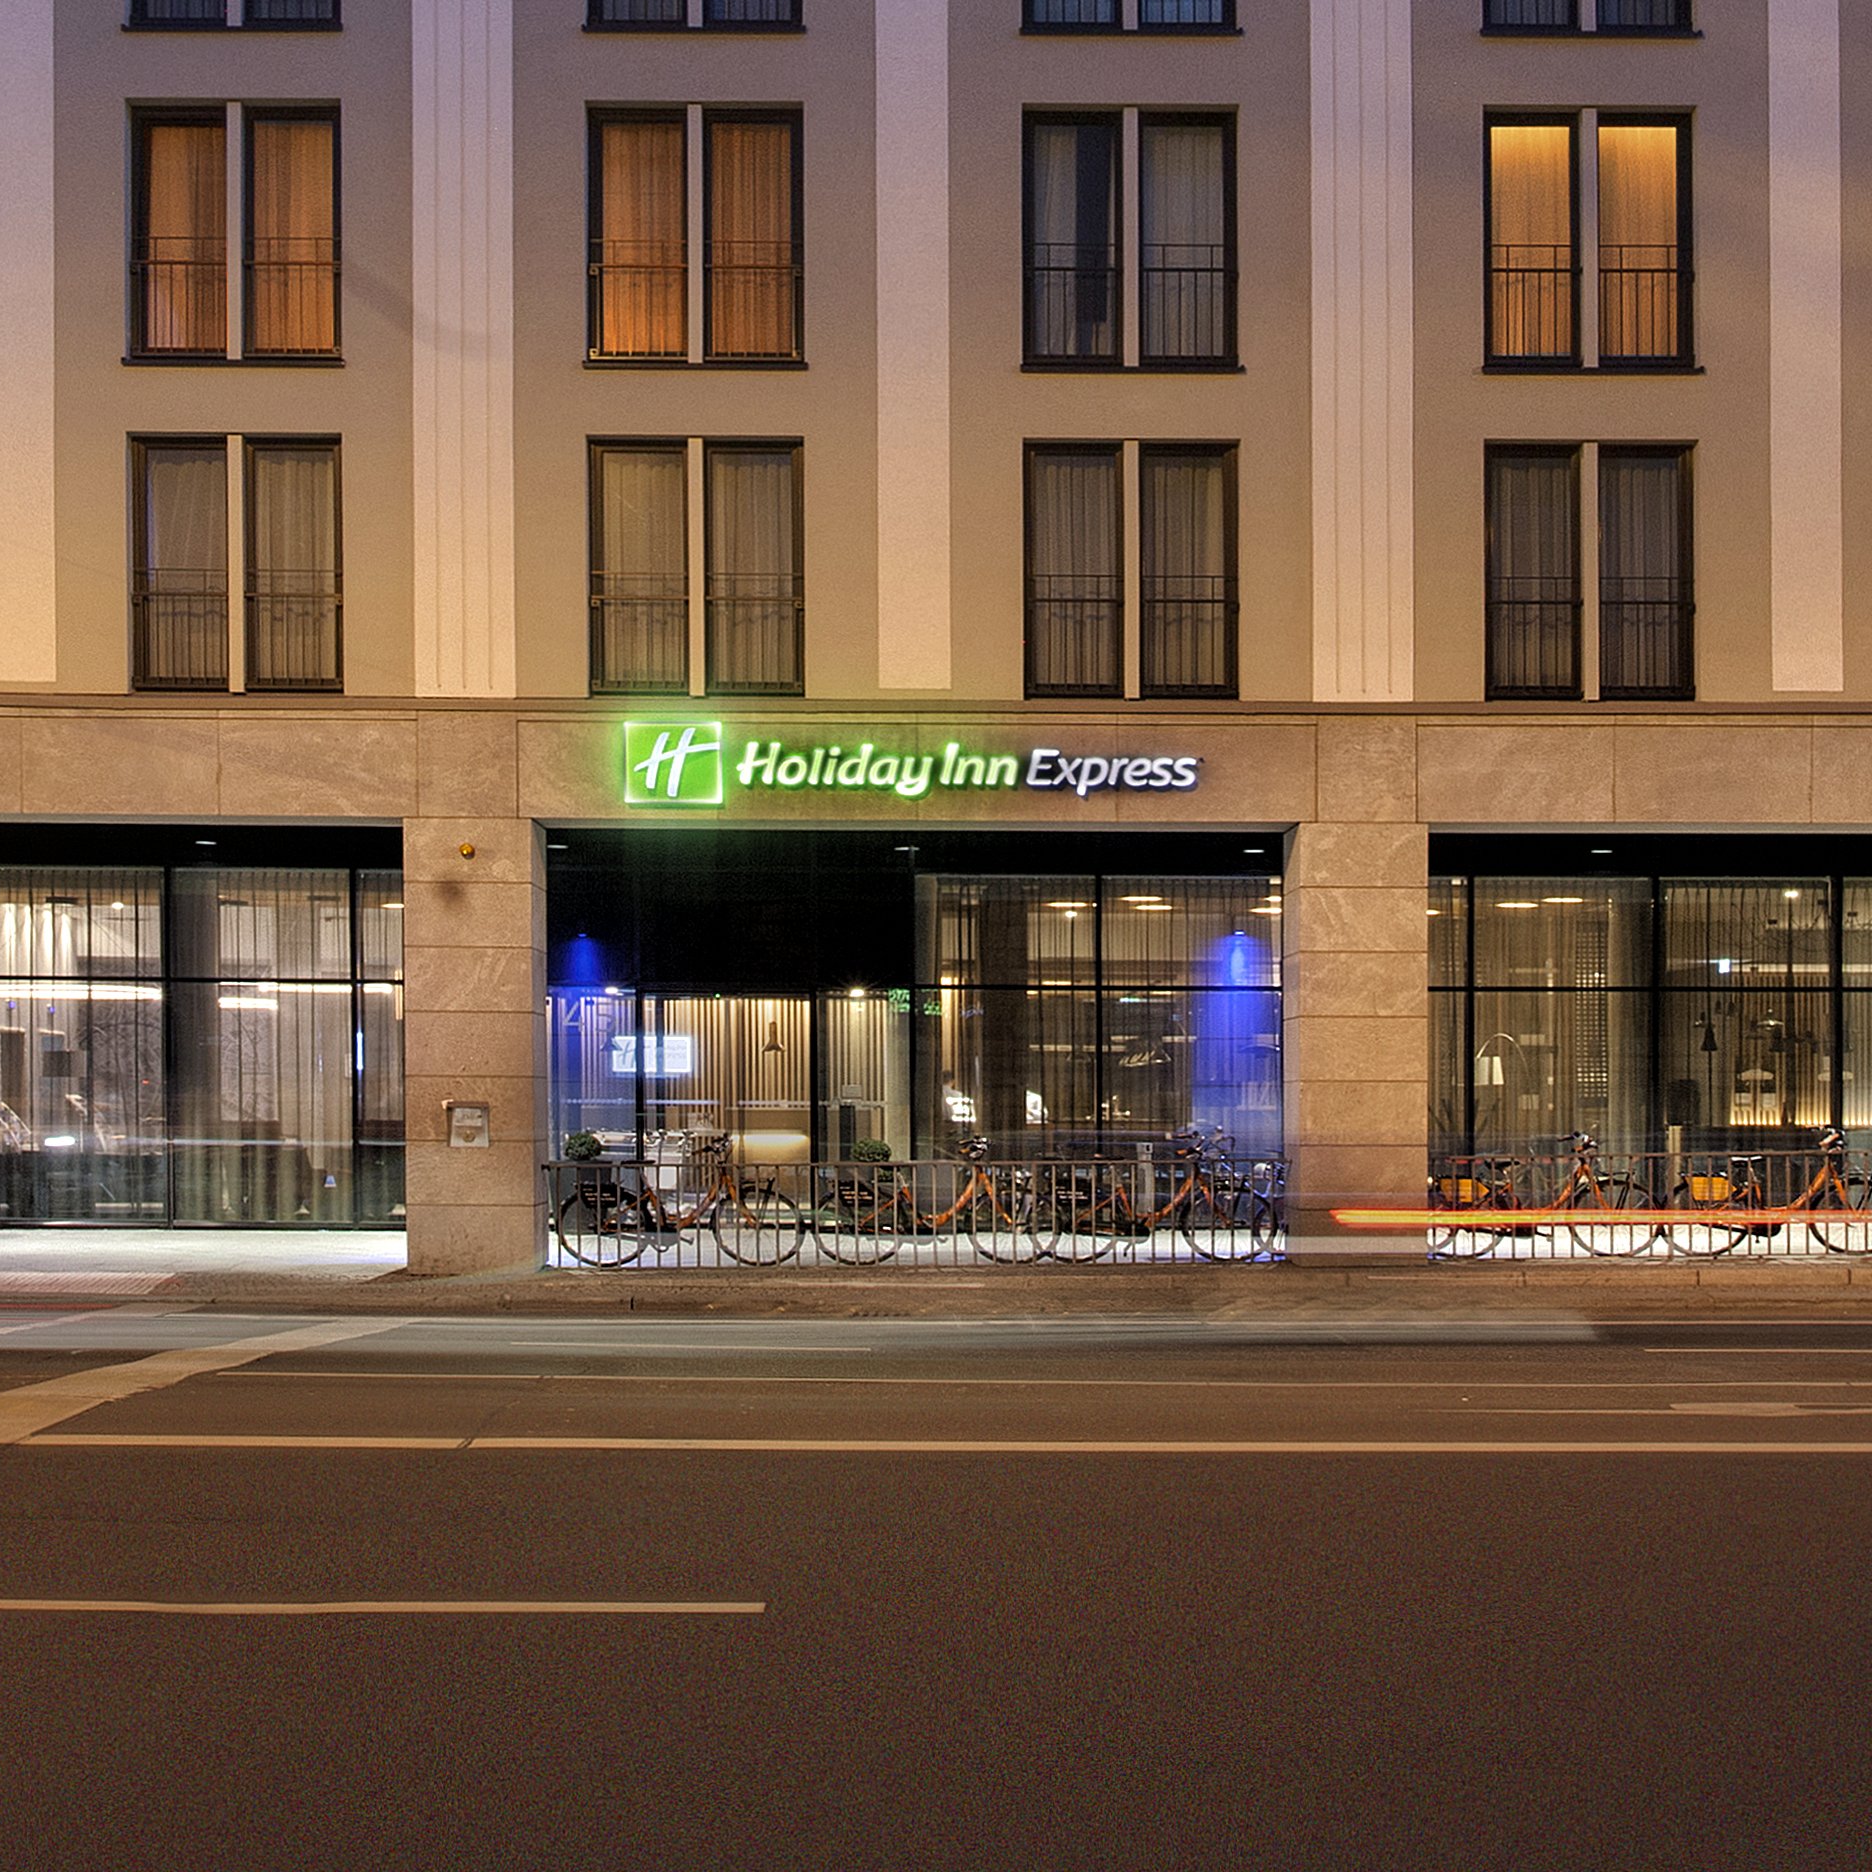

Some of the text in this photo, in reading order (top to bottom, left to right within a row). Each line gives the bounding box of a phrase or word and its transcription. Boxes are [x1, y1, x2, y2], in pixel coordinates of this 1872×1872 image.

[736, 741, 1197, 796] Holiday Inn Express
